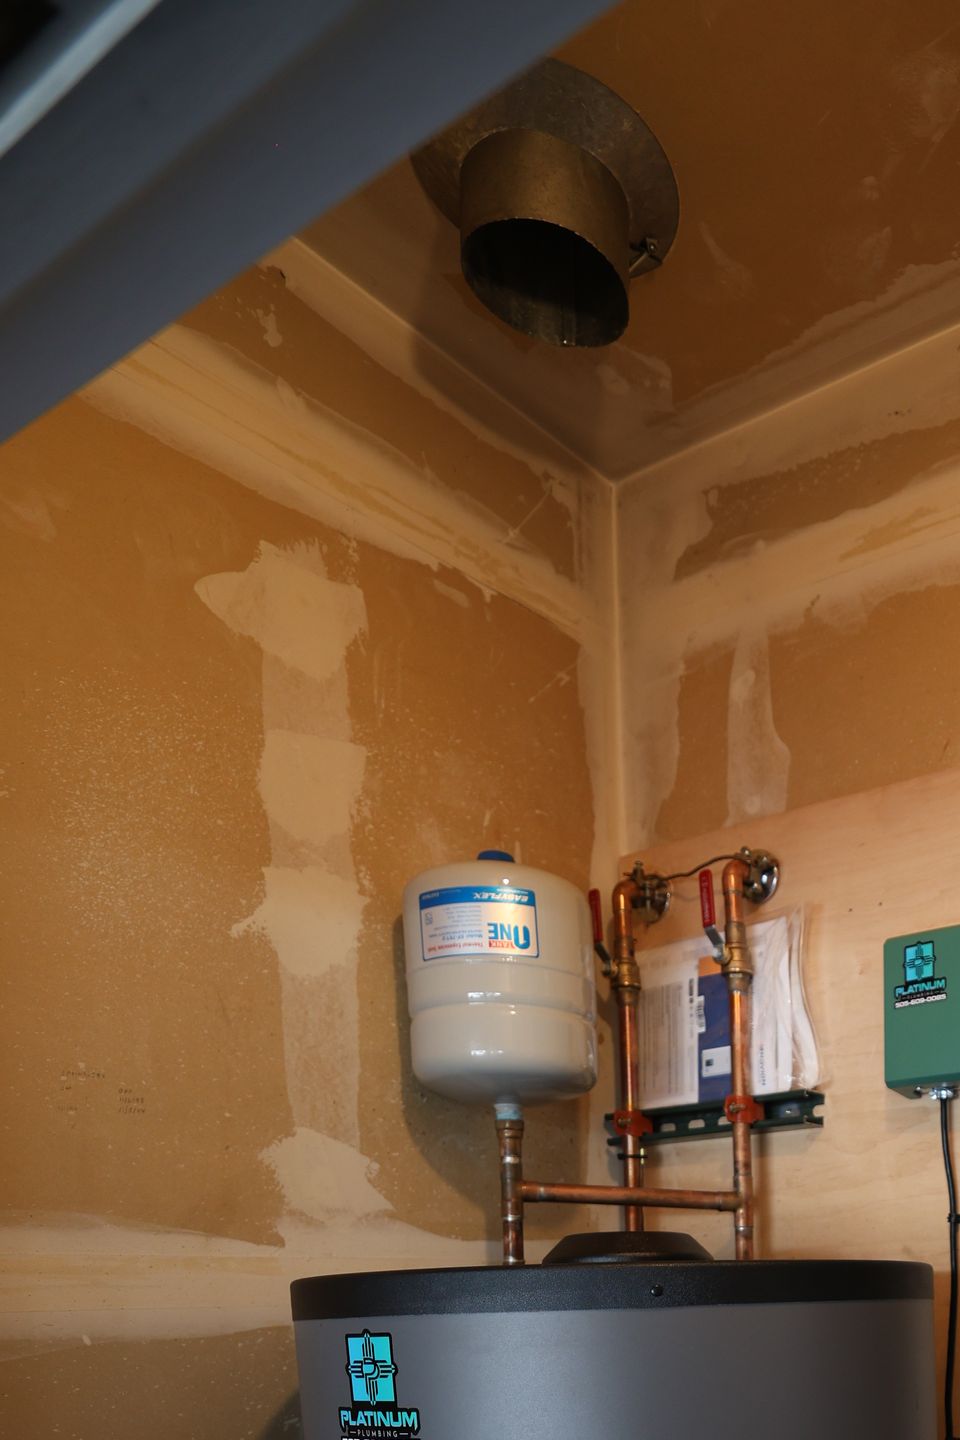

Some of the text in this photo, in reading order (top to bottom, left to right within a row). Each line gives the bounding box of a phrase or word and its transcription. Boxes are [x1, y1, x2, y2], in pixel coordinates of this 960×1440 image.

[895, 979, 946, 997] PLATINUM
[340, 1410, 418, 1431] PLATINUM
[357, 1429, 398, 1438] PLUMBING
